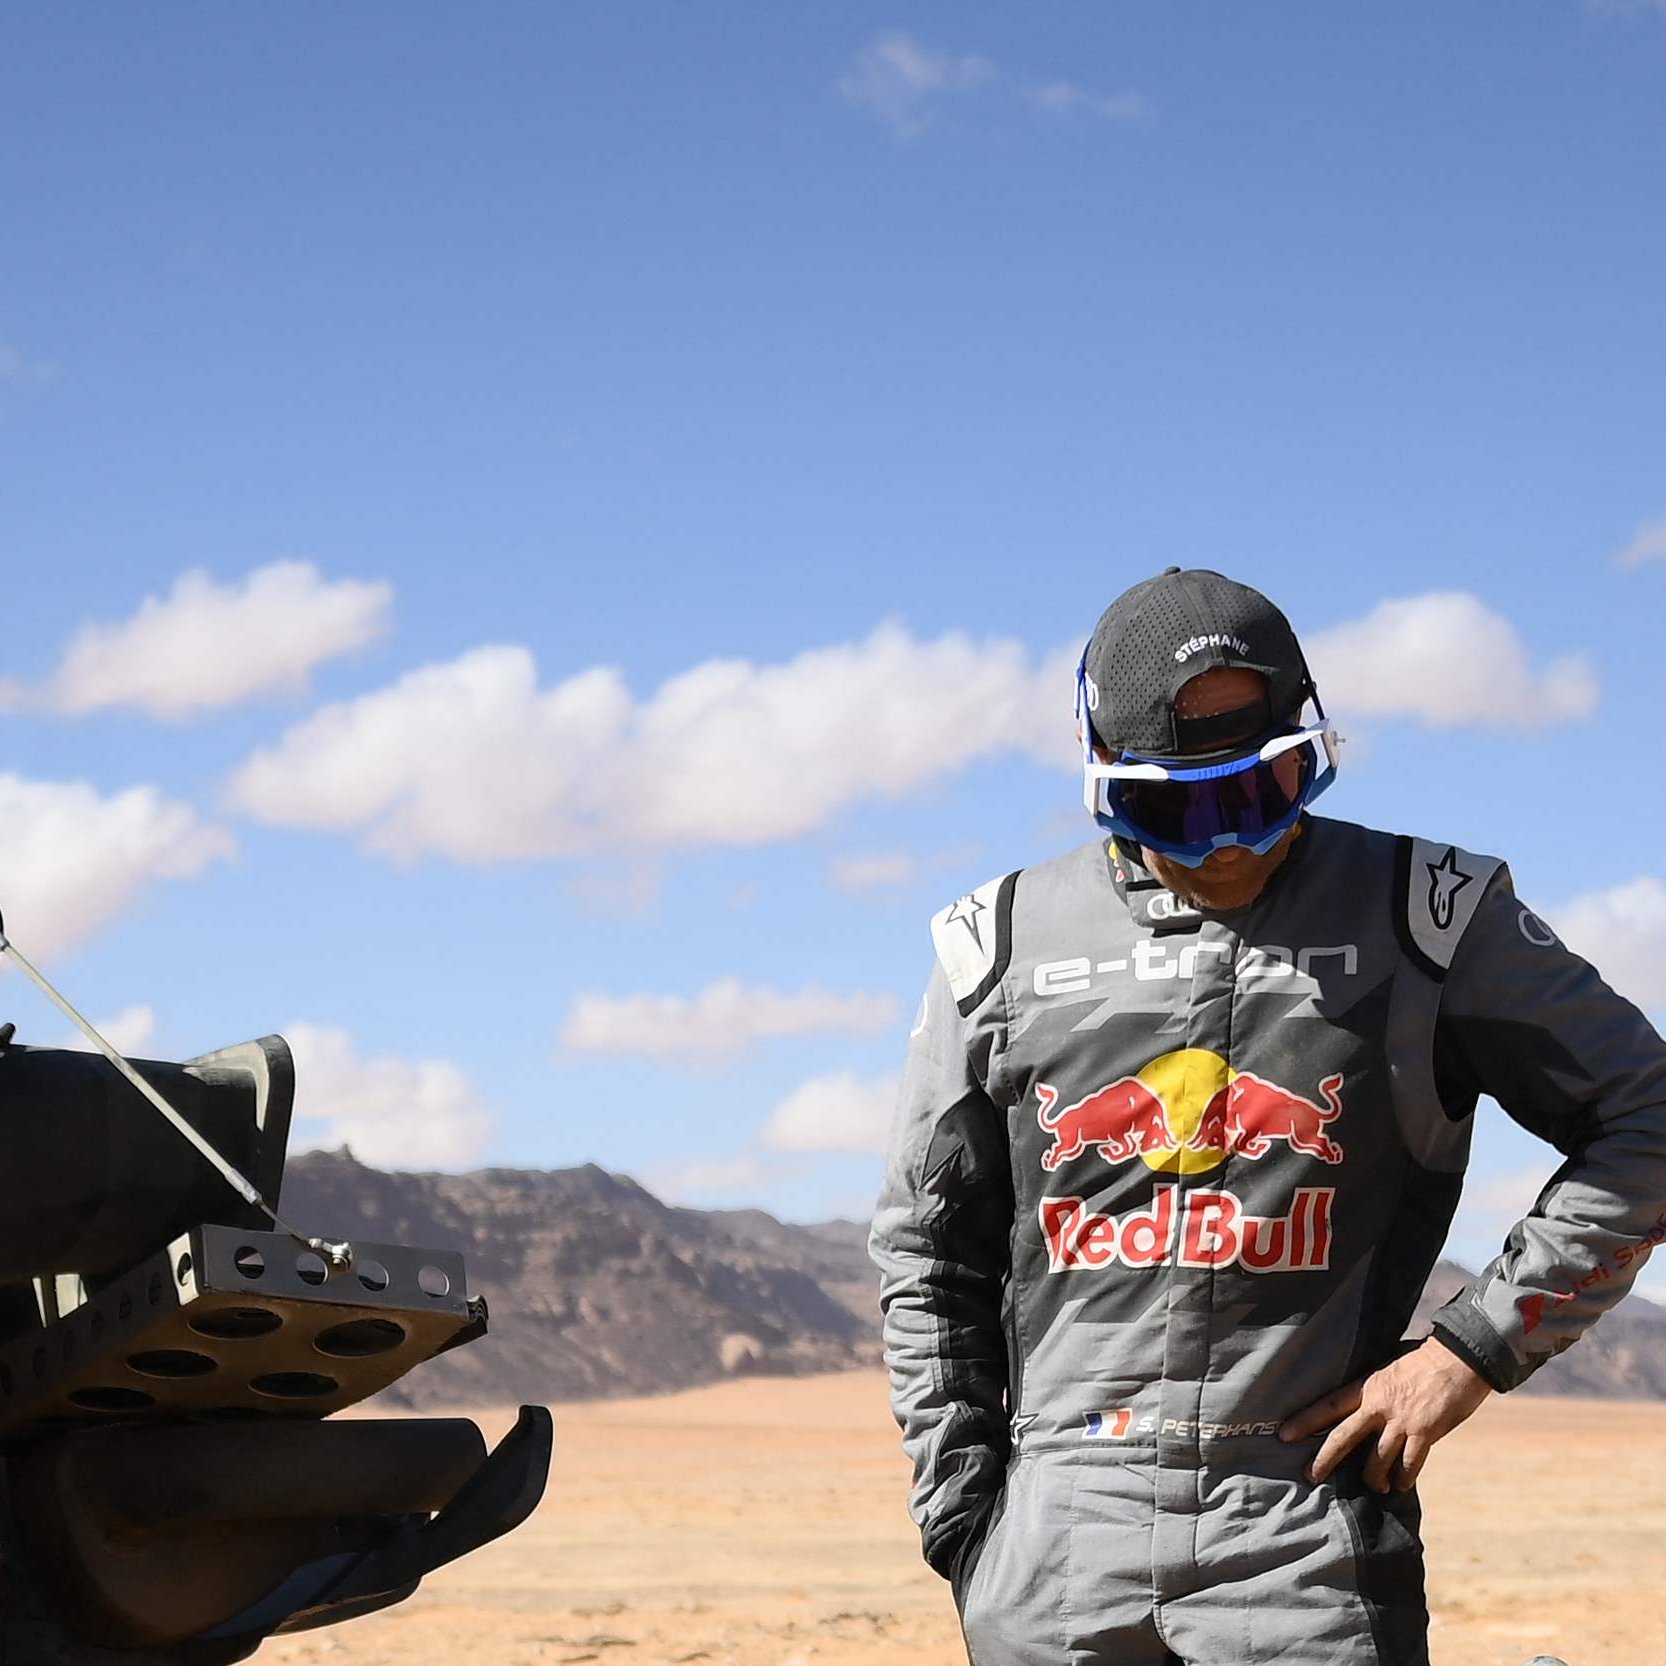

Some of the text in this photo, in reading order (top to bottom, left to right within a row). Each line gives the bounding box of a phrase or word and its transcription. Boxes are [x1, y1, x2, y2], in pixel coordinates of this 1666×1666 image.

[1174, 633, 1250, 663] STÉPHANE
[1033, 939, 1358, 996] e-tron
[1039, 1183, 1334, 1273] Red Bull
[1135, 1416, 1285, 1439] S. PETERHANS
